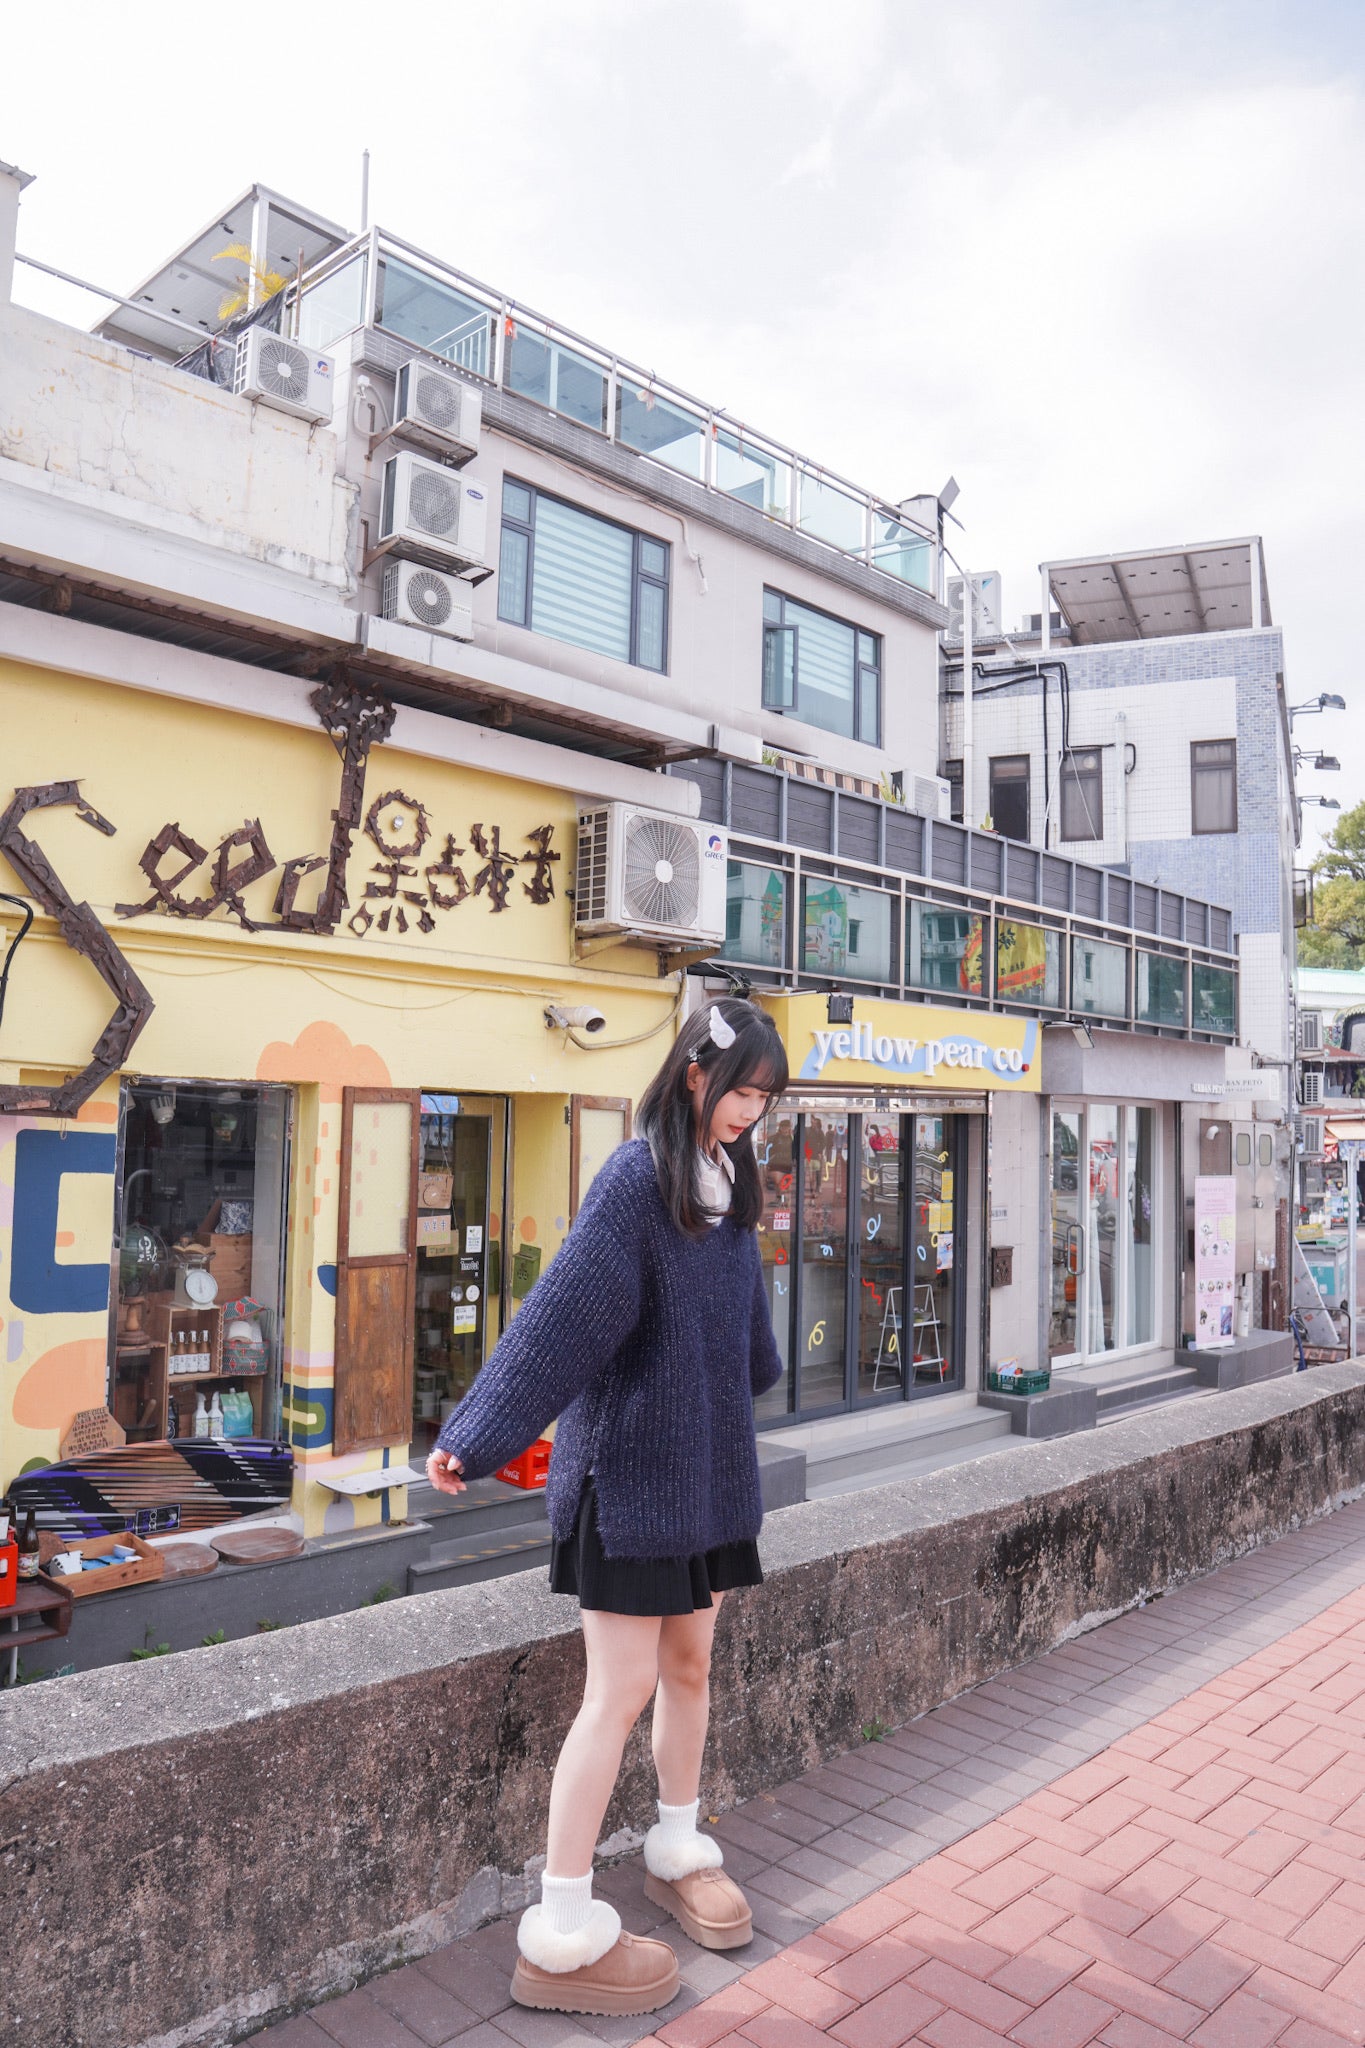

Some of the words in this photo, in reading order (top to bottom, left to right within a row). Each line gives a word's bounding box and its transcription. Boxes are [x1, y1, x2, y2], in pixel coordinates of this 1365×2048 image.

[704, 850, 725, 861] GREE
[811, 1020, 918, 1071] yellow
[923, 1038, 988, 1077] pear
[992, 1046, 1030, 1073] co.
